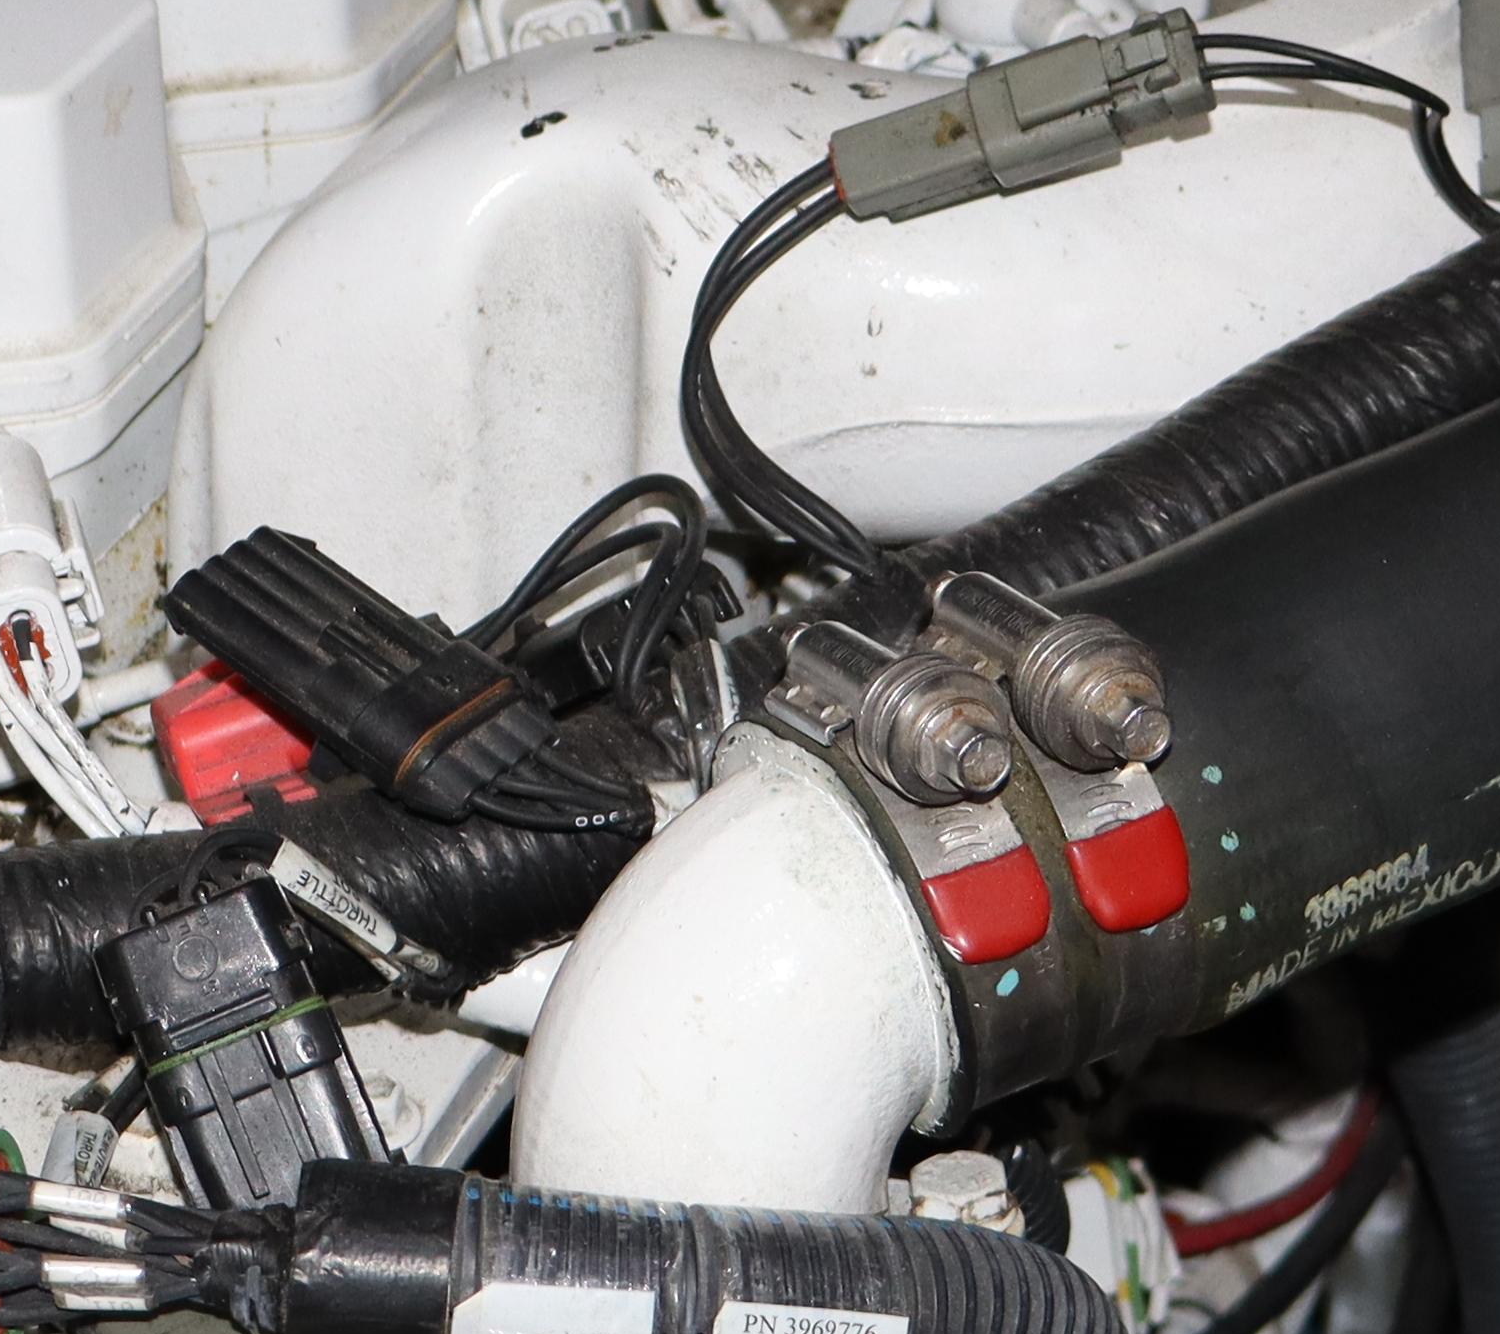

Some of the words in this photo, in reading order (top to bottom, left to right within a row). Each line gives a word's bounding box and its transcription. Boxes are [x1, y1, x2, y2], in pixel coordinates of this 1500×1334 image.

[298, 868, 378, 938] THROTTLE
[1329, 922, 1362, 955] IN
[743, 1313, 777, 1334] PN
